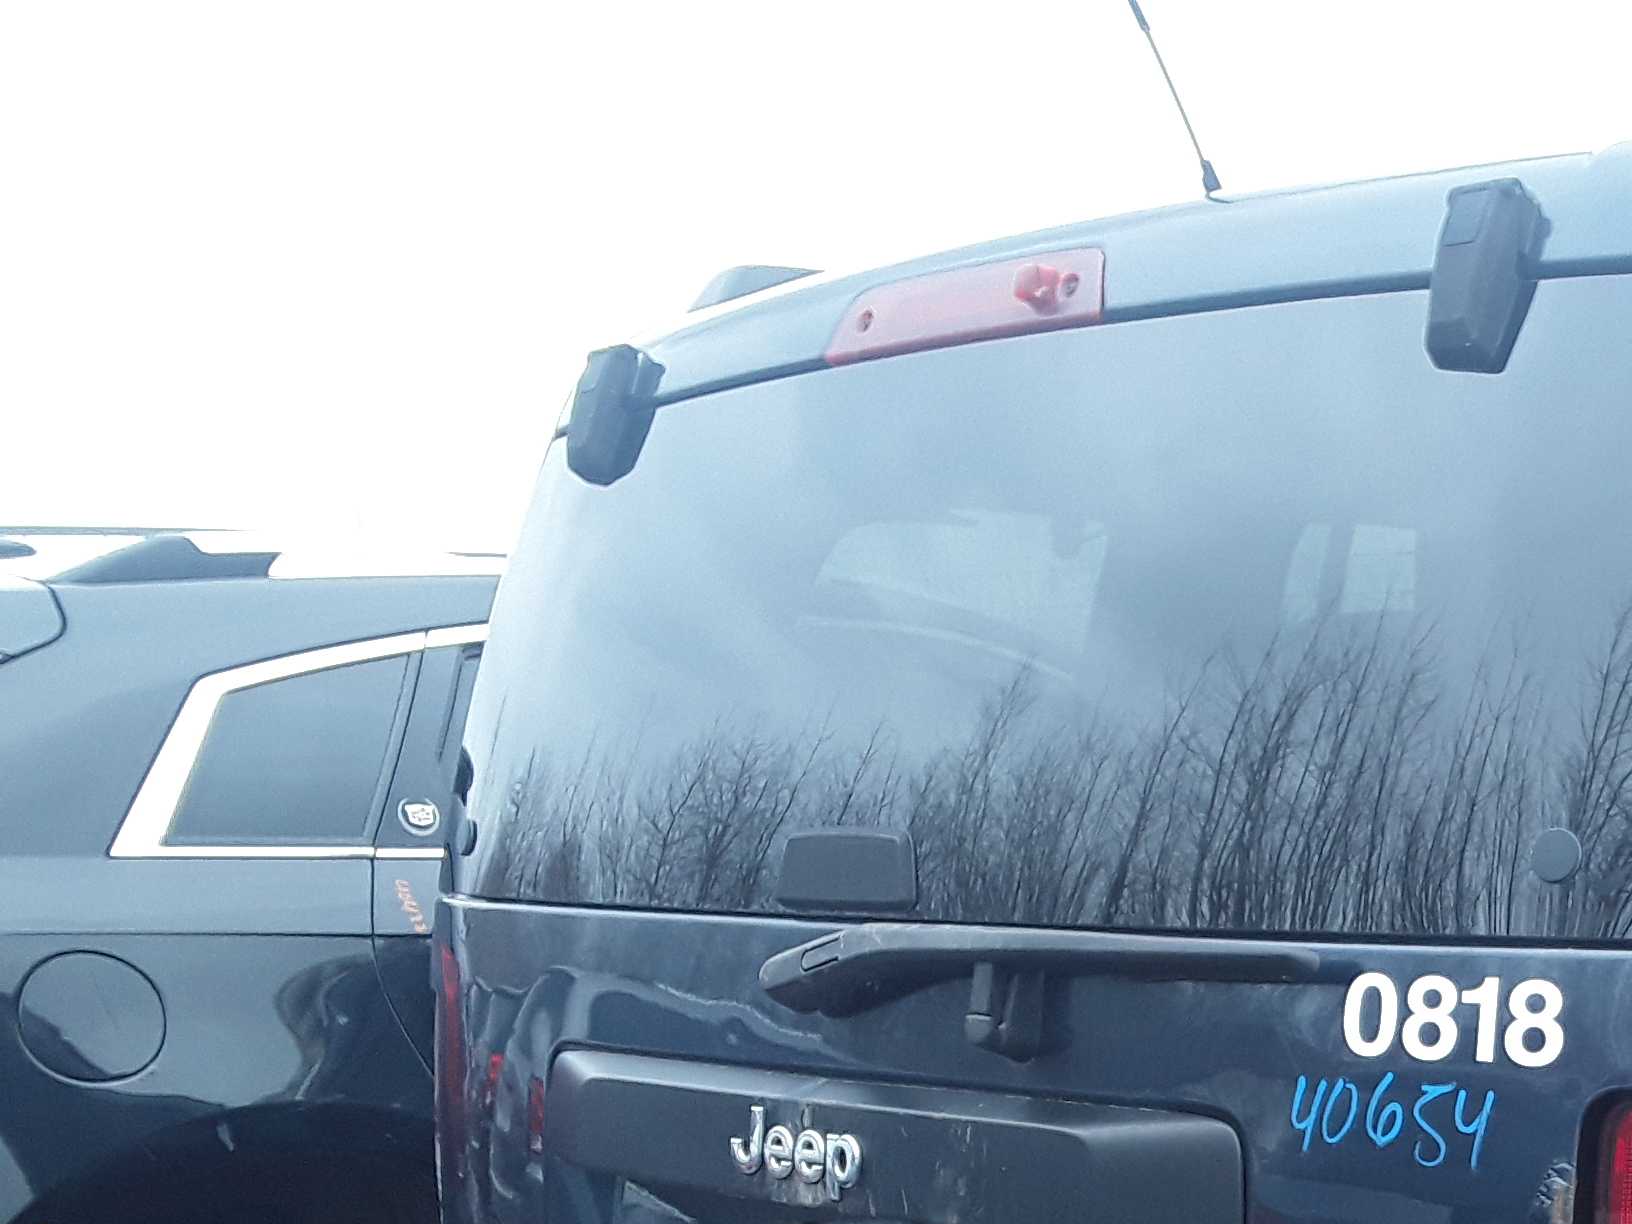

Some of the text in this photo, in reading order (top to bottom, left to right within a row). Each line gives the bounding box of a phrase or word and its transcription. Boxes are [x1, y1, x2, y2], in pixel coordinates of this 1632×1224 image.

[1343, 972, 1564, 1067] 0818
[730, 1105, 861, 1200] Jeep
[1288, 1070, 1500, 1171] 40654
